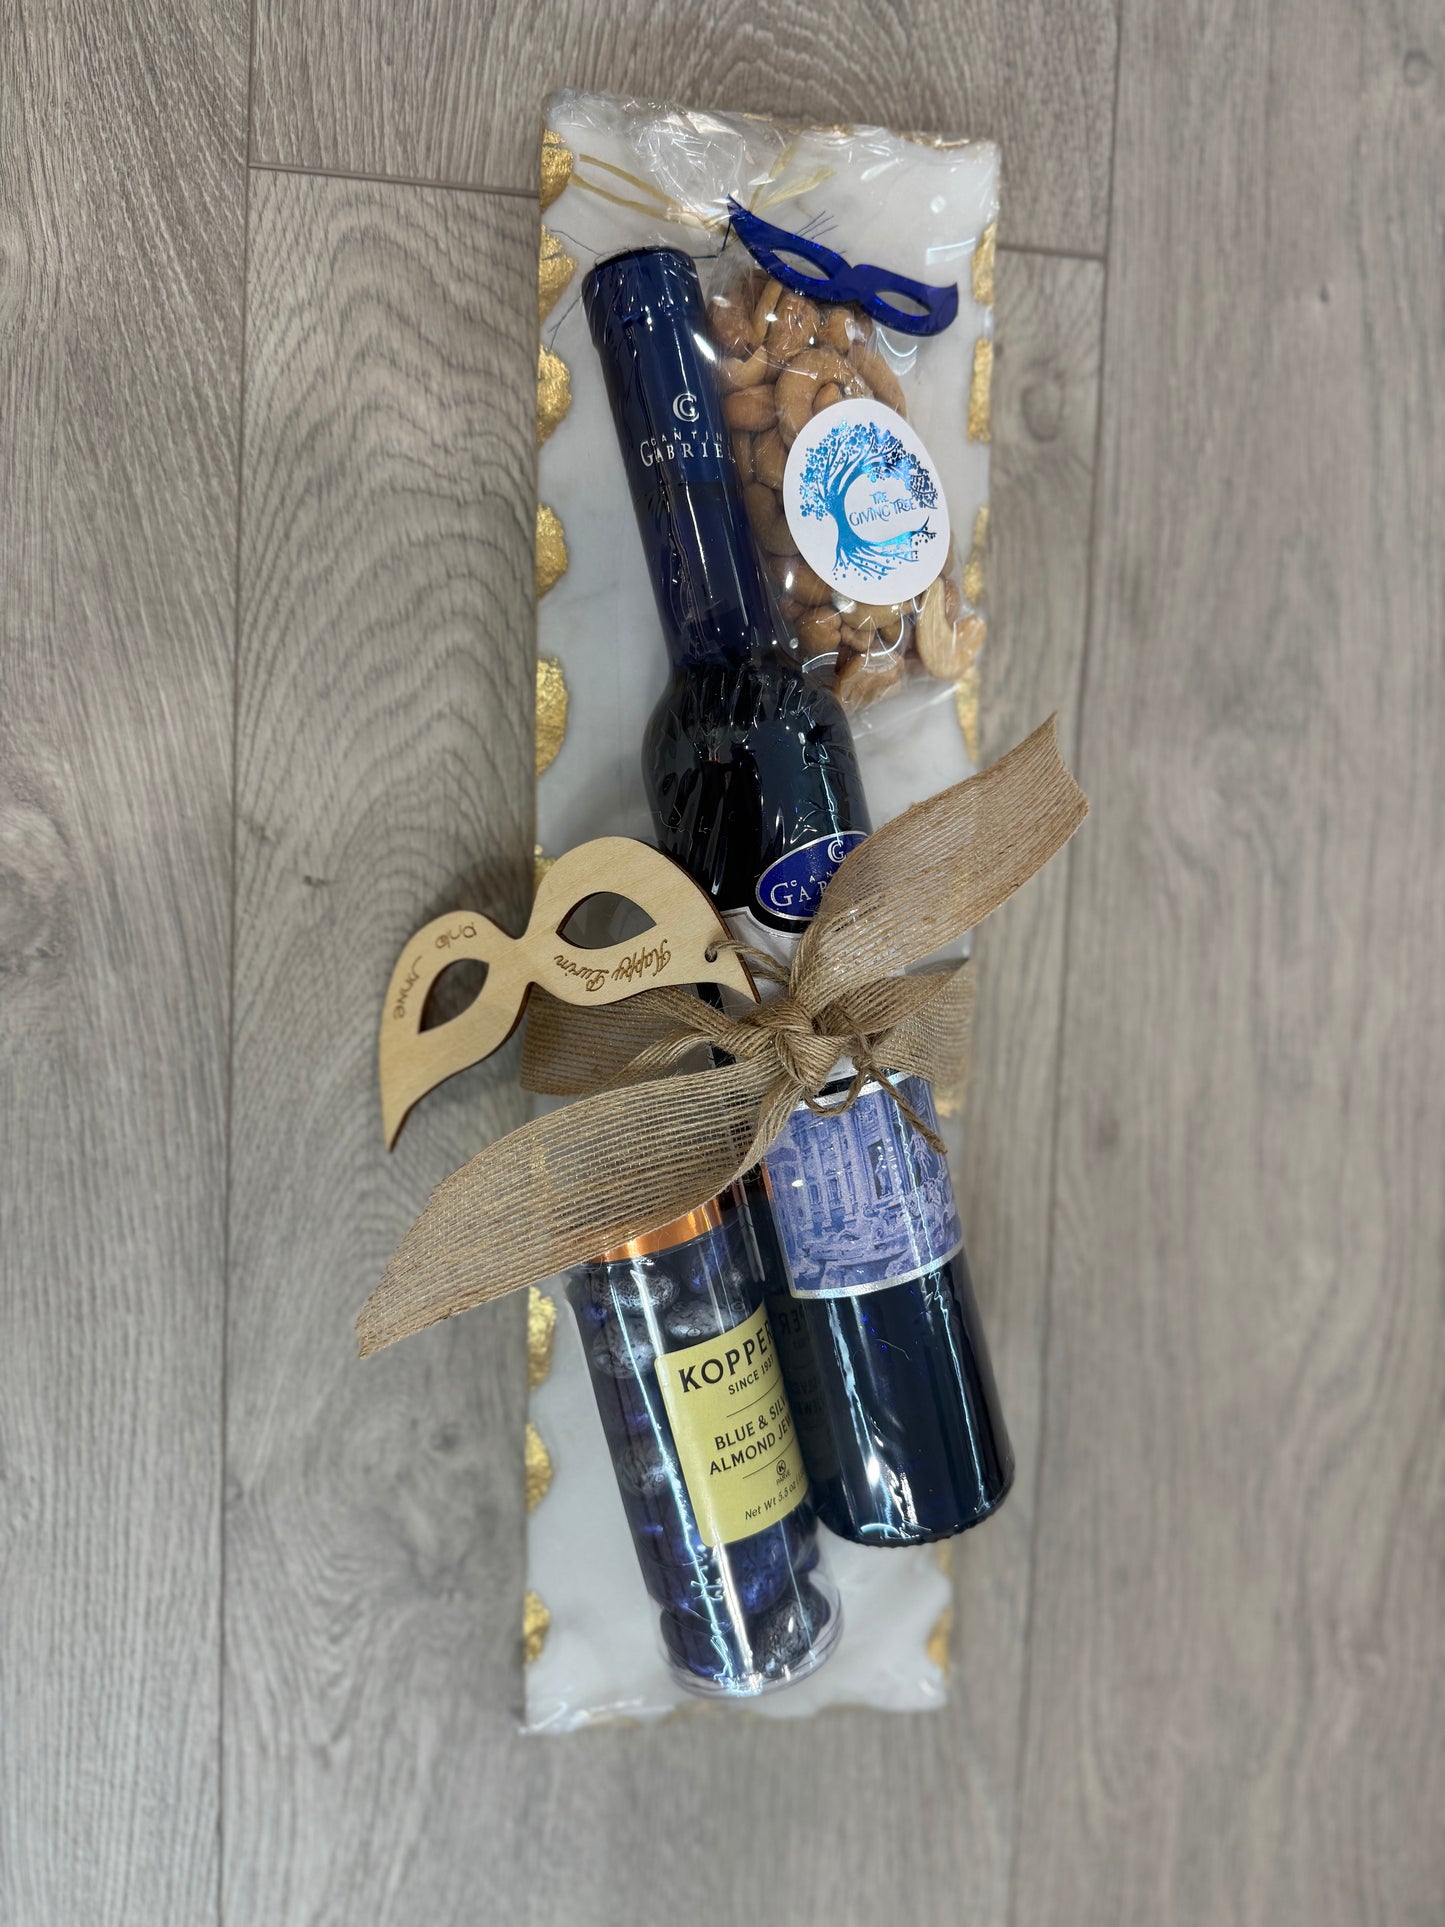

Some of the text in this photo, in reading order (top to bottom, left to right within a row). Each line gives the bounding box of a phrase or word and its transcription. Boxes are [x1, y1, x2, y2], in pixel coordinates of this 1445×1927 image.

[553, 938, 672, 992] Happy Purim
[728, 1369, 760, 1395] SINCE
[714, 1420, 756, 1451] BLUE
[757, 1414, 769, 1430] &
[709, 1432, 777, 1476] ALMOND
[744, 1505, 762, 1521] Net
[763, 1497, 777, 1512] Wt
